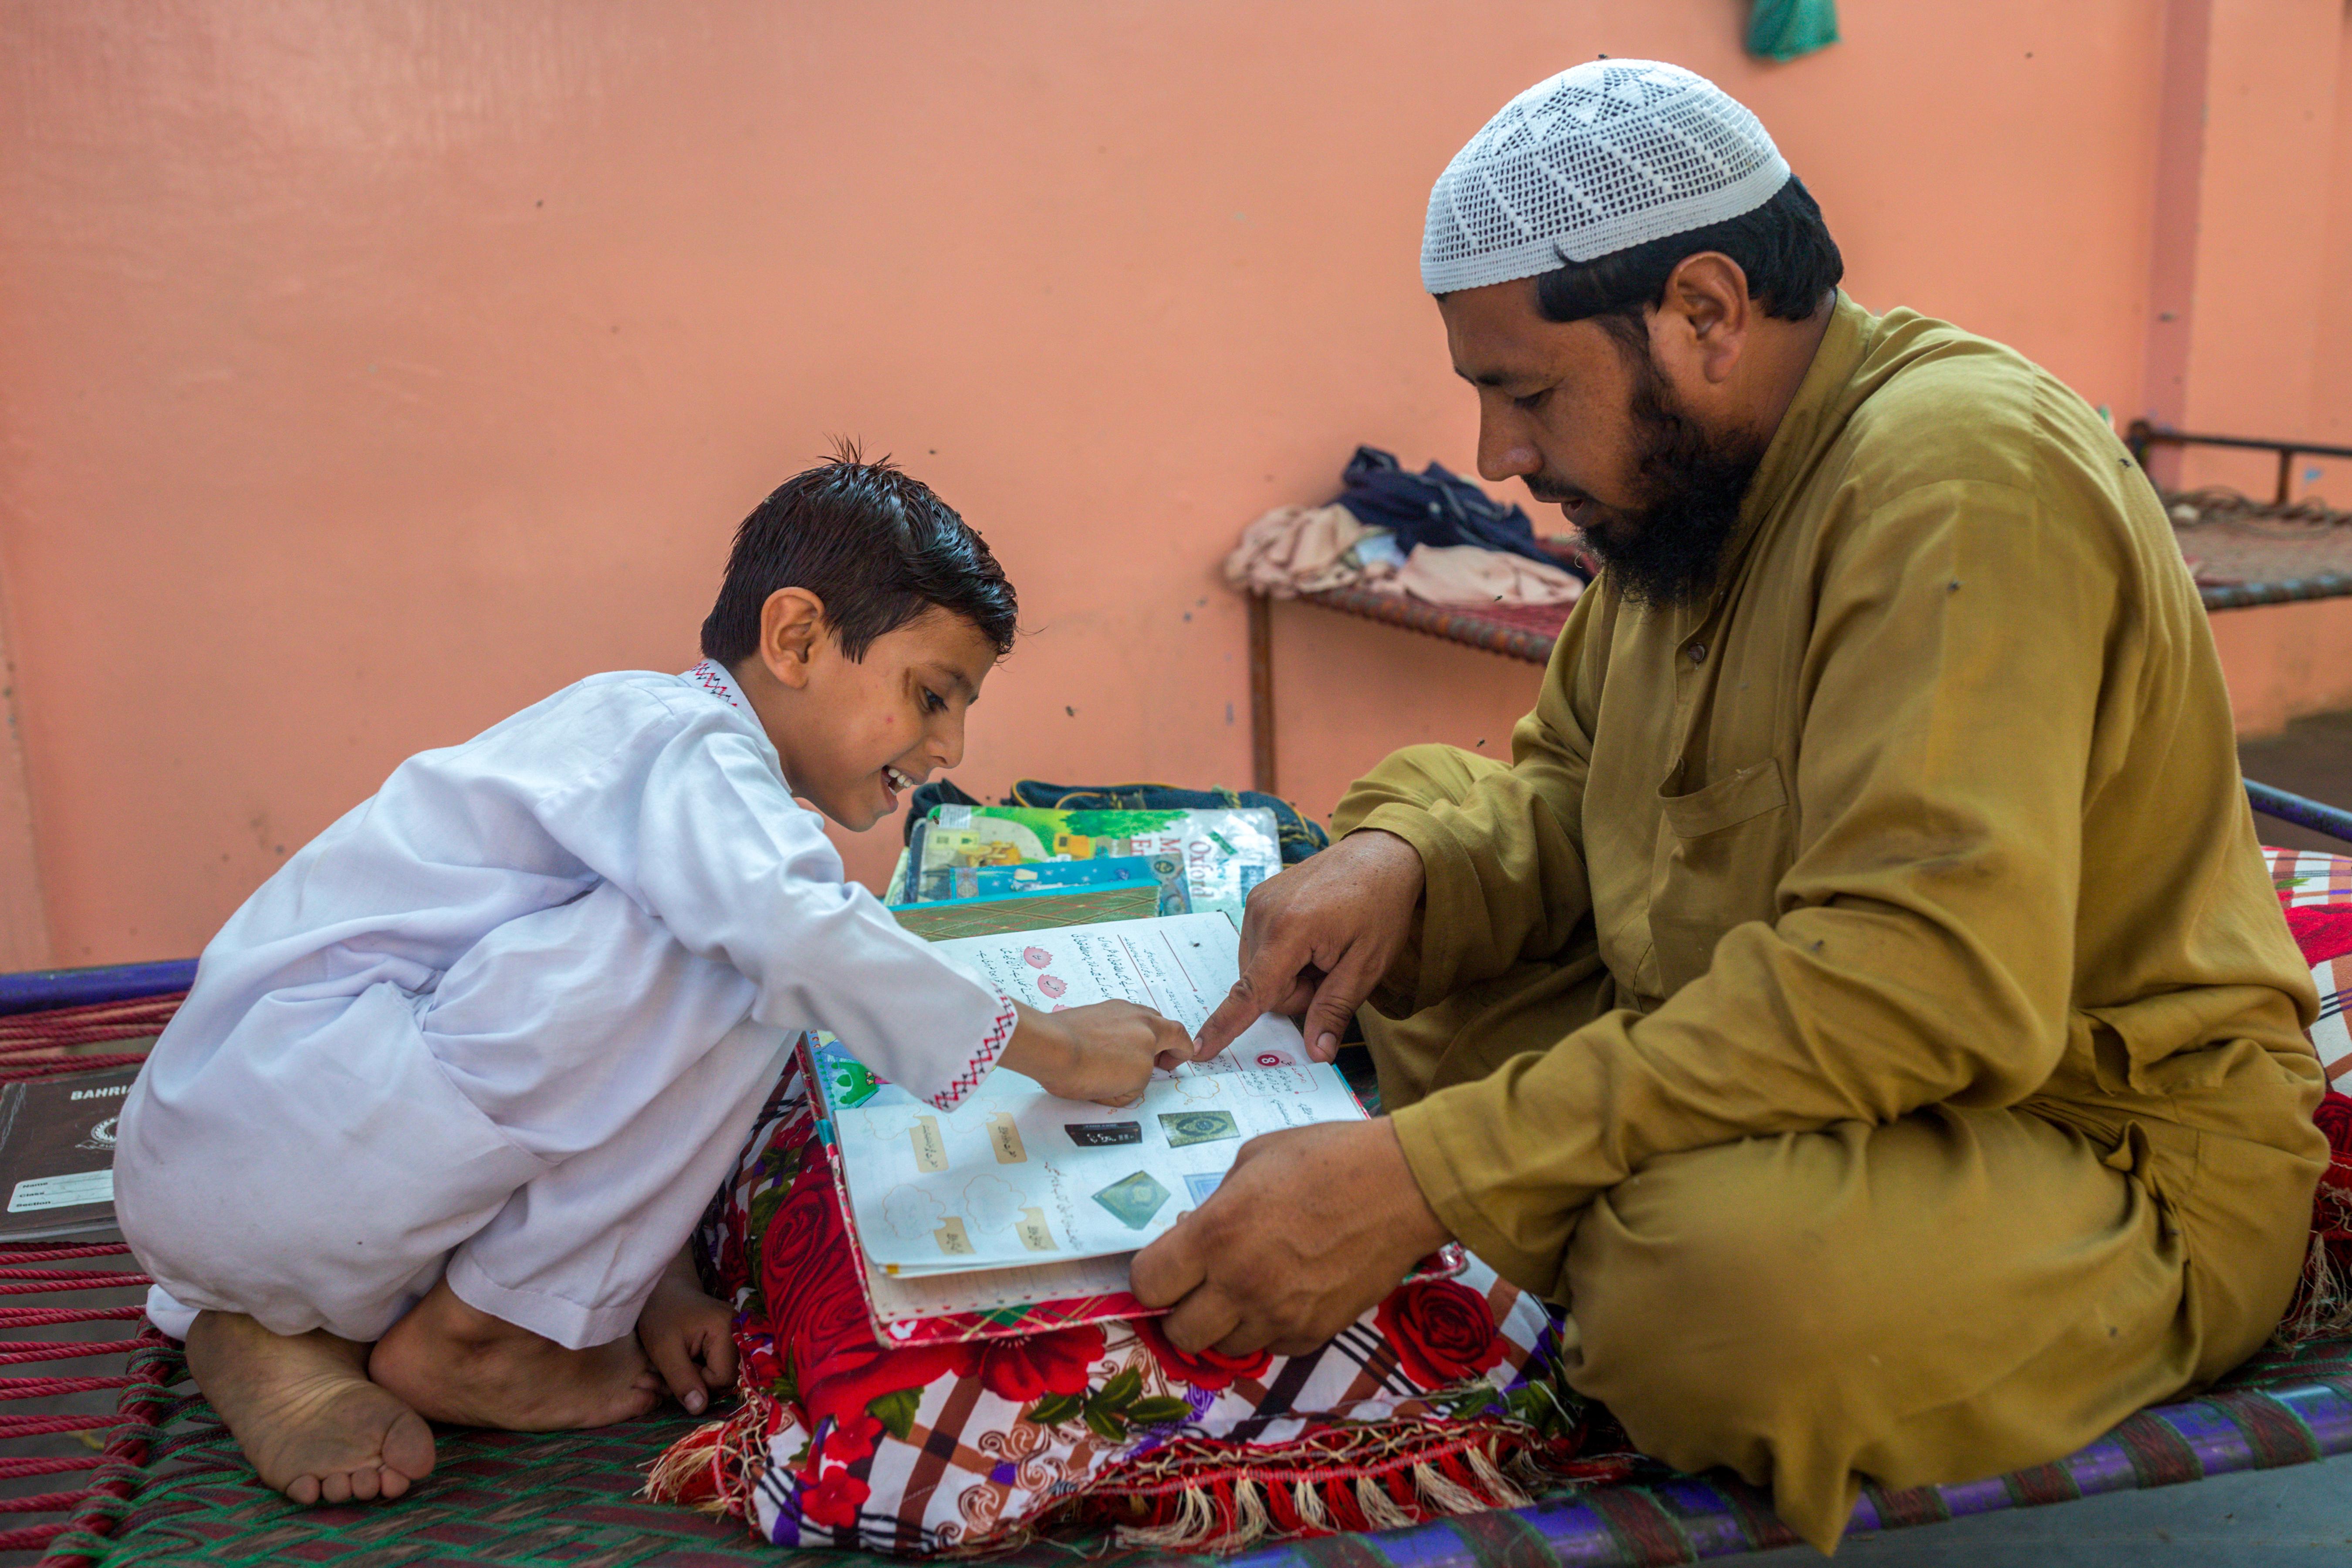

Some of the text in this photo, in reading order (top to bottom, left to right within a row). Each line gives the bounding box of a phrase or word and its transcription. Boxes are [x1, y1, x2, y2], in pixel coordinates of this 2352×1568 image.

[1189, 841, 1214, 897] Oxford
[1217, 859, 1230, 879] New
[982, 960, 997, 970] ضروری
[1014, 978, 1033, 987] سکھایا
[1044, 981, 1060, 991] مغرب
[1096, 977, 1113, 988] کرتے
